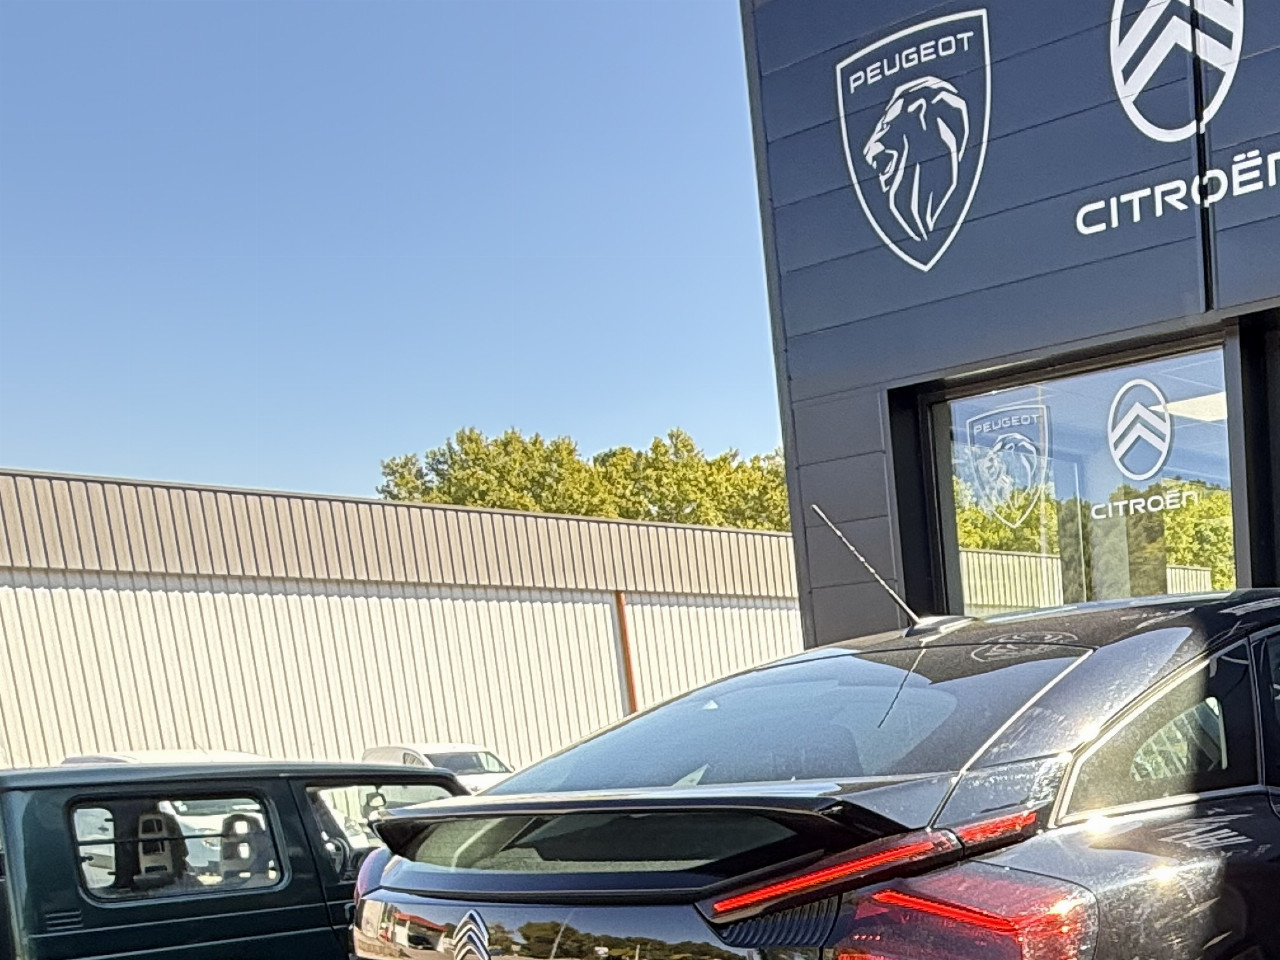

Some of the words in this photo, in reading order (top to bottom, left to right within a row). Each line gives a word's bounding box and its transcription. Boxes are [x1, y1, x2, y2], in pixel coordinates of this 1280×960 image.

[849, 31, 975, 94] PEUGEOT
[972, 414, 1040, 436] PEUGEOT
[1091, 489, 1198, 520] CITROËN
